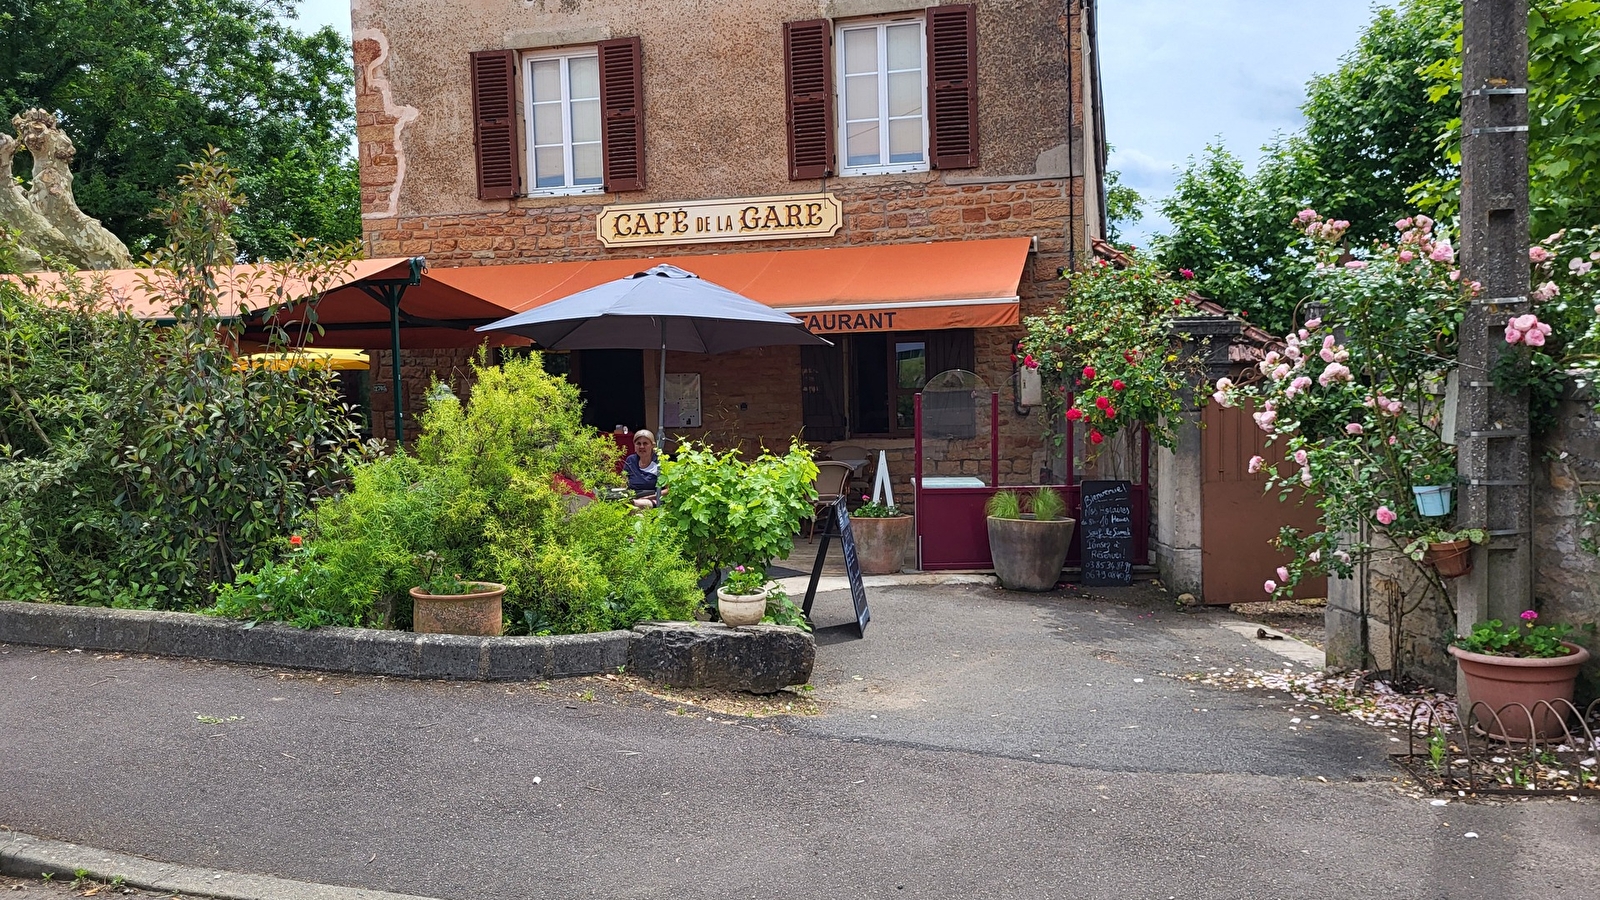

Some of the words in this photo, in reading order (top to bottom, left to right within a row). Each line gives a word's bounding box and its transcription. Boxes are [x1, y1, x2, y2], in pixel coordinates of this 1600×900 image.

[612, 207, 689, 239] CAFÉ
[696, 216, 711, 232] DE
[716, 215, 734, 232] LA
[739, 202, 823, 234] GARE
